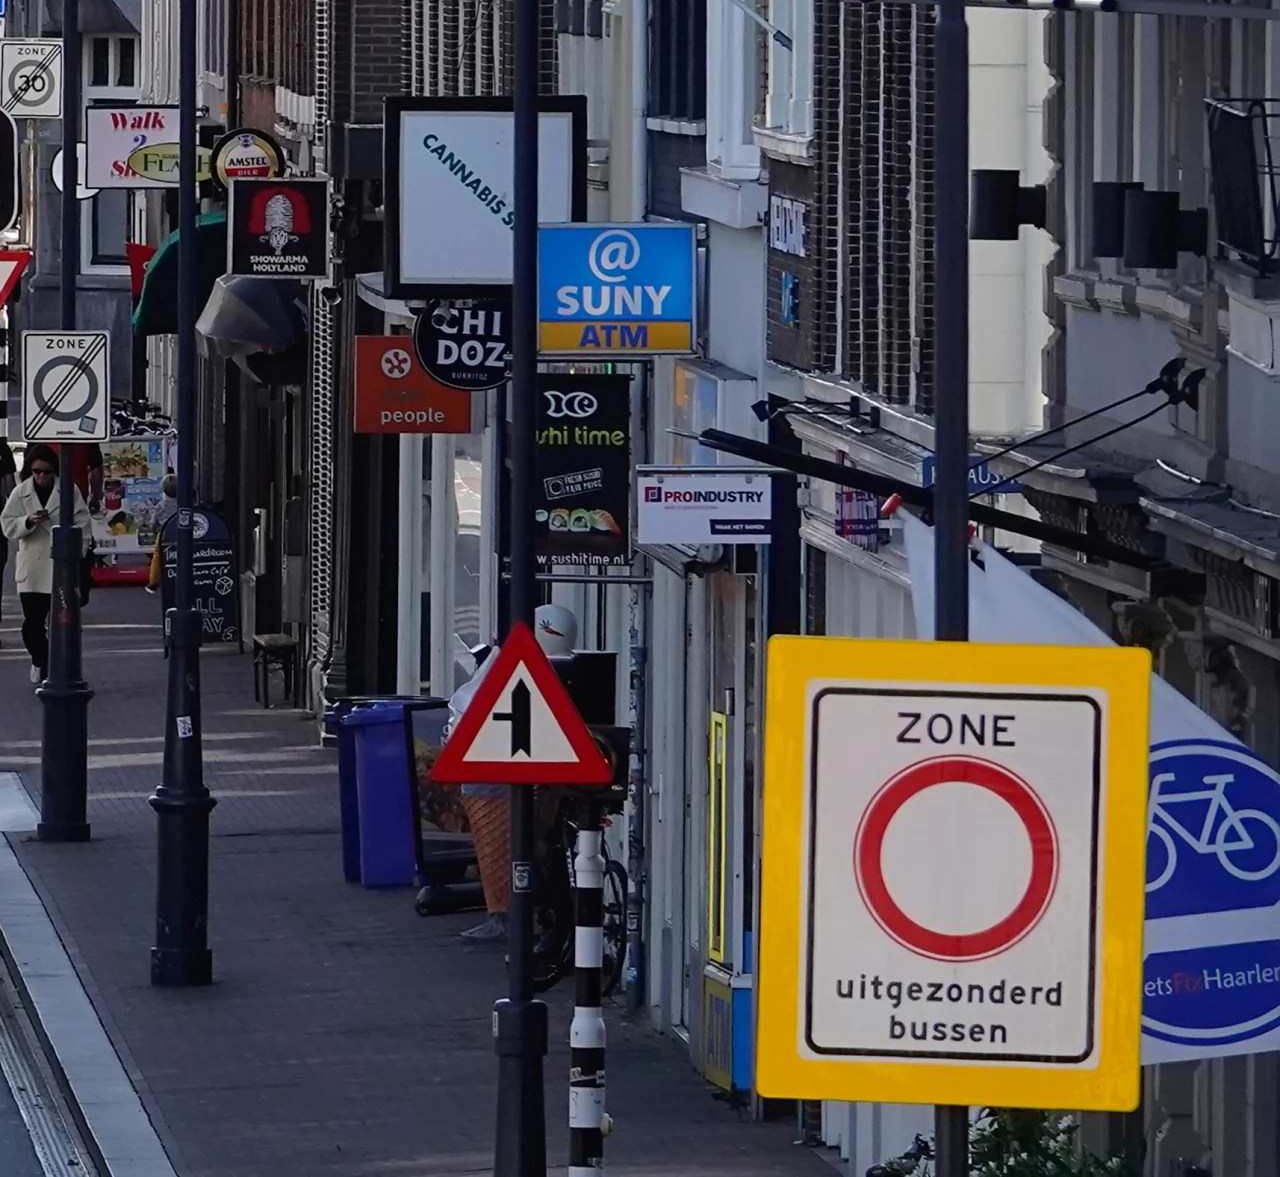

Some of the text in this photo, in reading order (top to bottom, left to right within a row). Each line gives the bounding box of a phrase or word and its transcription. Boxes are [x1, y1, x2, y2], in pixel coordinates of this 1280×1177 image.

[17, 47, 46, 56] ZONE
[18, 74, 46, 92] 30
[109, 112, 165, 130] Walk
[130, 134, 147, 153] 2
[228, 157, 268, 166] AMSTEL
[422, 133, 507, 215] CANNABIS
[249, 255, 309, 264] SHOWARMA
[253, 264, 306, 273] HOLYLAND
[556, 285, 672, 316] SUNY
[440, 308, 502, 336] CHI
[45, 338, 86, 349] ZONE
[578, 325, 648, 348] ATM
[451, 372, 488, 380] BURRITOZ
[380, 408, 445, 425] people
[536, 425, 625, 446] shi time
[664, 491, 764, 503] PROINDUSTRY
[196, 597, 223, 614] LL
[202, 617, 225, 633] AY
[895, 711, 1017, 748] ZONE
[835, 973, 1064, 1009] uitgezonderd
[889, 1015, 1009, 1044] bussen
